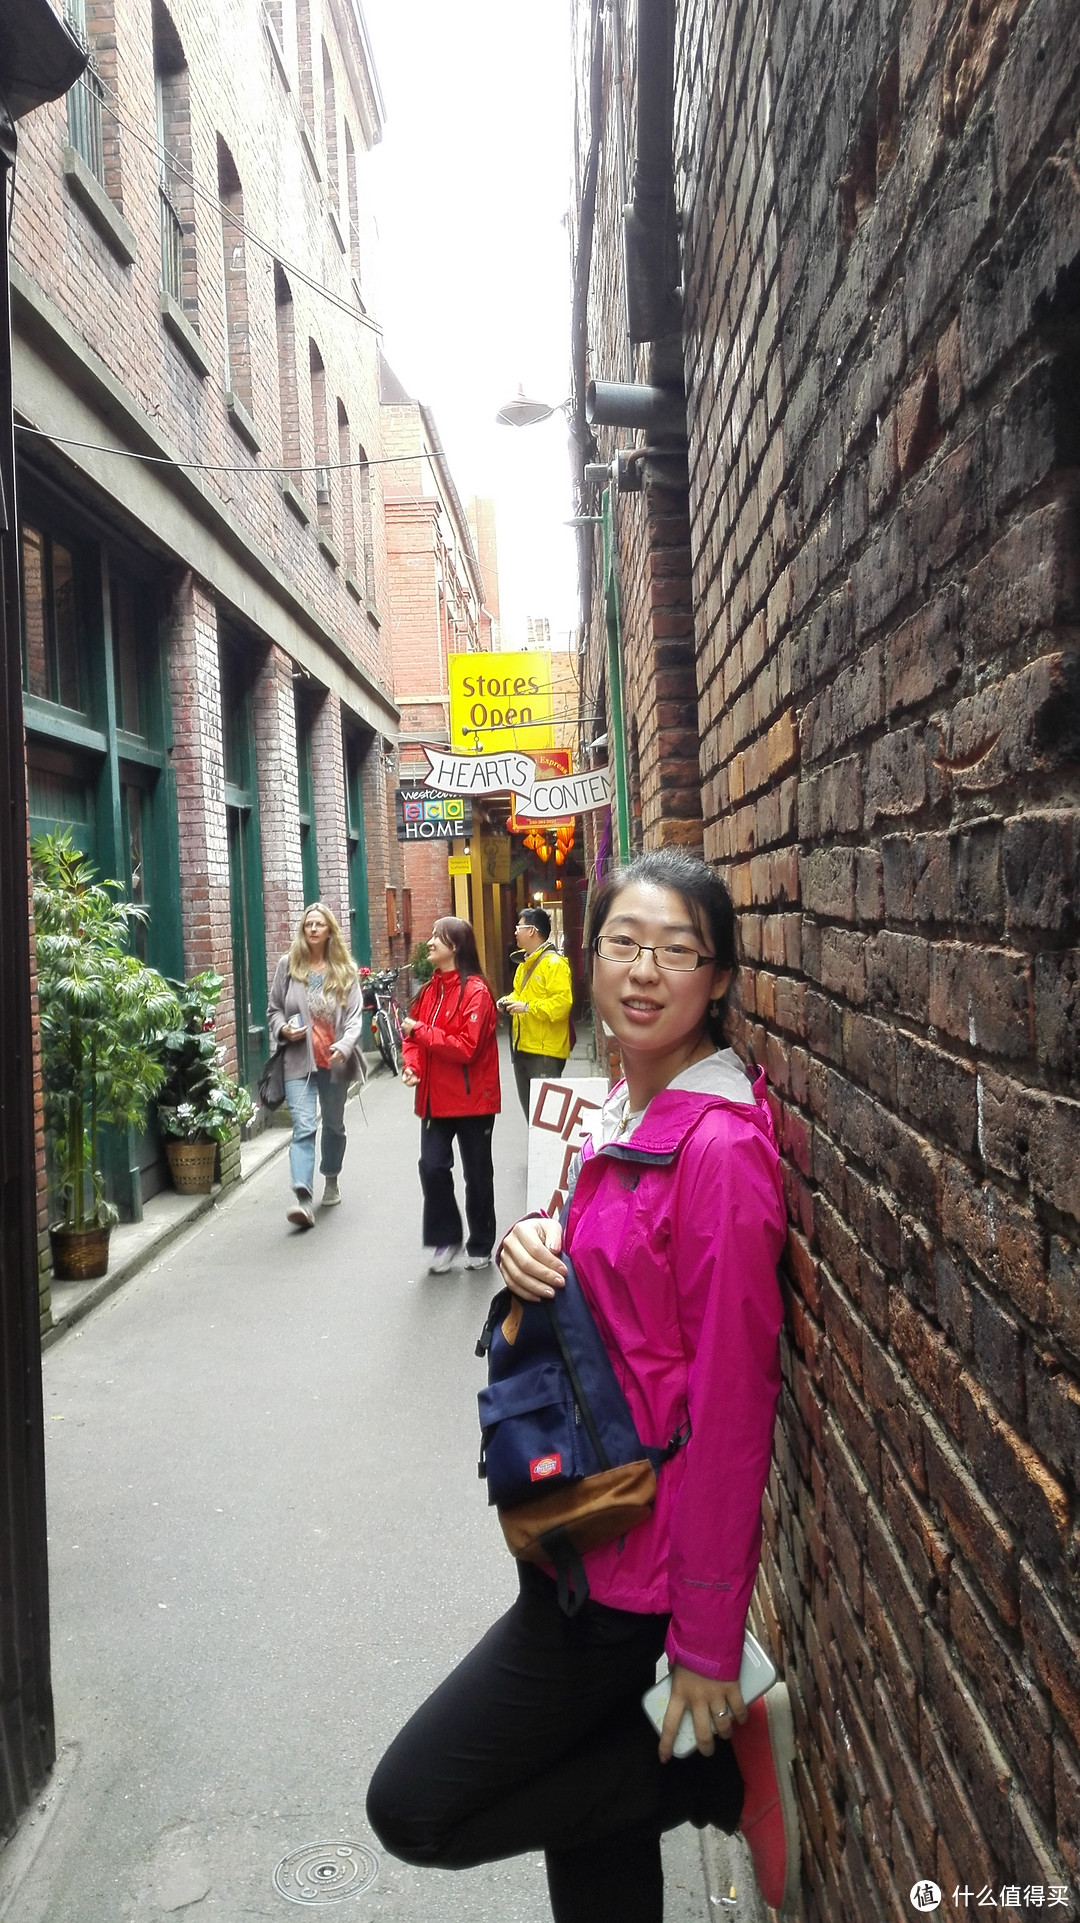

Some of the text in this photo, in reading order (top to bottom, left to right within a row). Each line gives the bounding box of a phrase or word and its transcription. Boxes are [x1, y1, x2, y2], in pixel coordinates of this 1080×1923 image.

[462, 675, 539, 697] Stores
[470, 703, 532, 729] Open
[438, 757, 528, 788] HEART'S
[540, 757, 568, 775] Express
[406, 820, 464, 838] HOME
